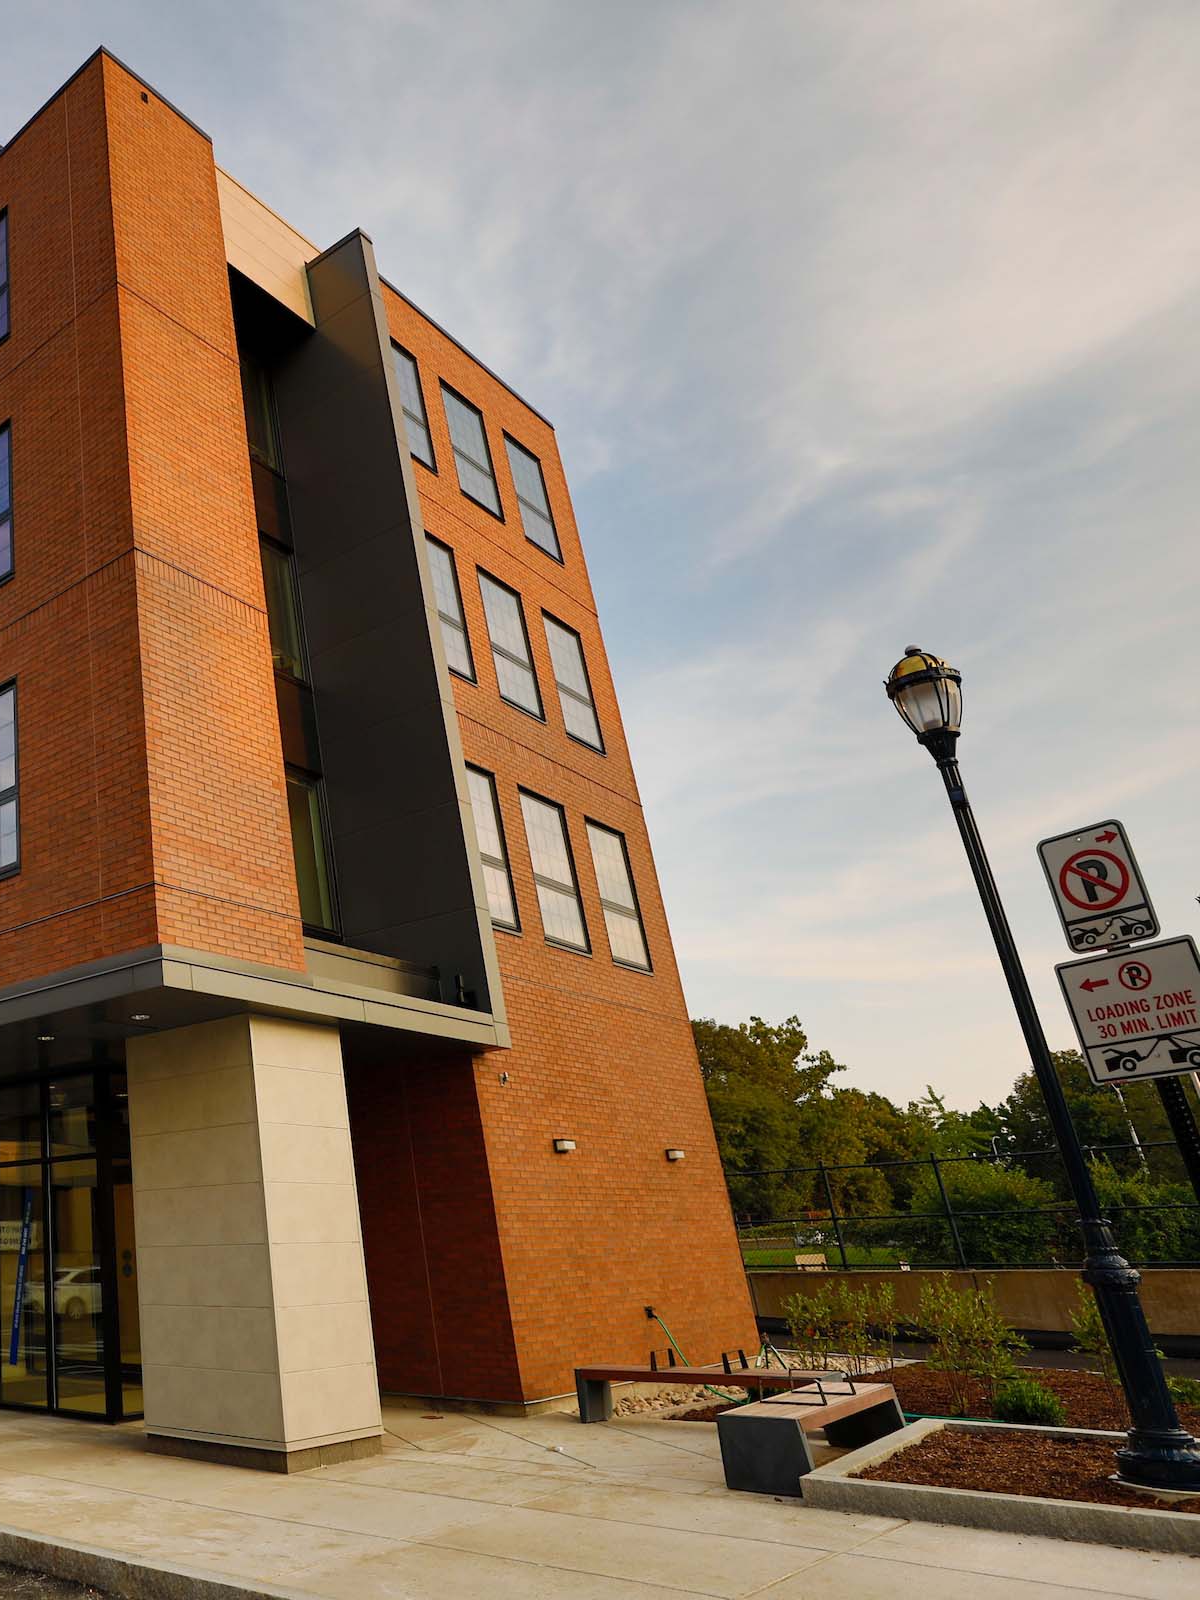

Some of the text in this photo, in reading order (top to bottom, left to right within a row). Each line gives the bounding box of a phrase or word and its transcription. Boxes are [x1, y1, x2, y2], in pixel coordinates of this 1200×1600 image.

[1086, 989, 1196, 1022] LOADING ZONE
[1097, 1009, 1198, 1039] 30 MIN. LIMIT
